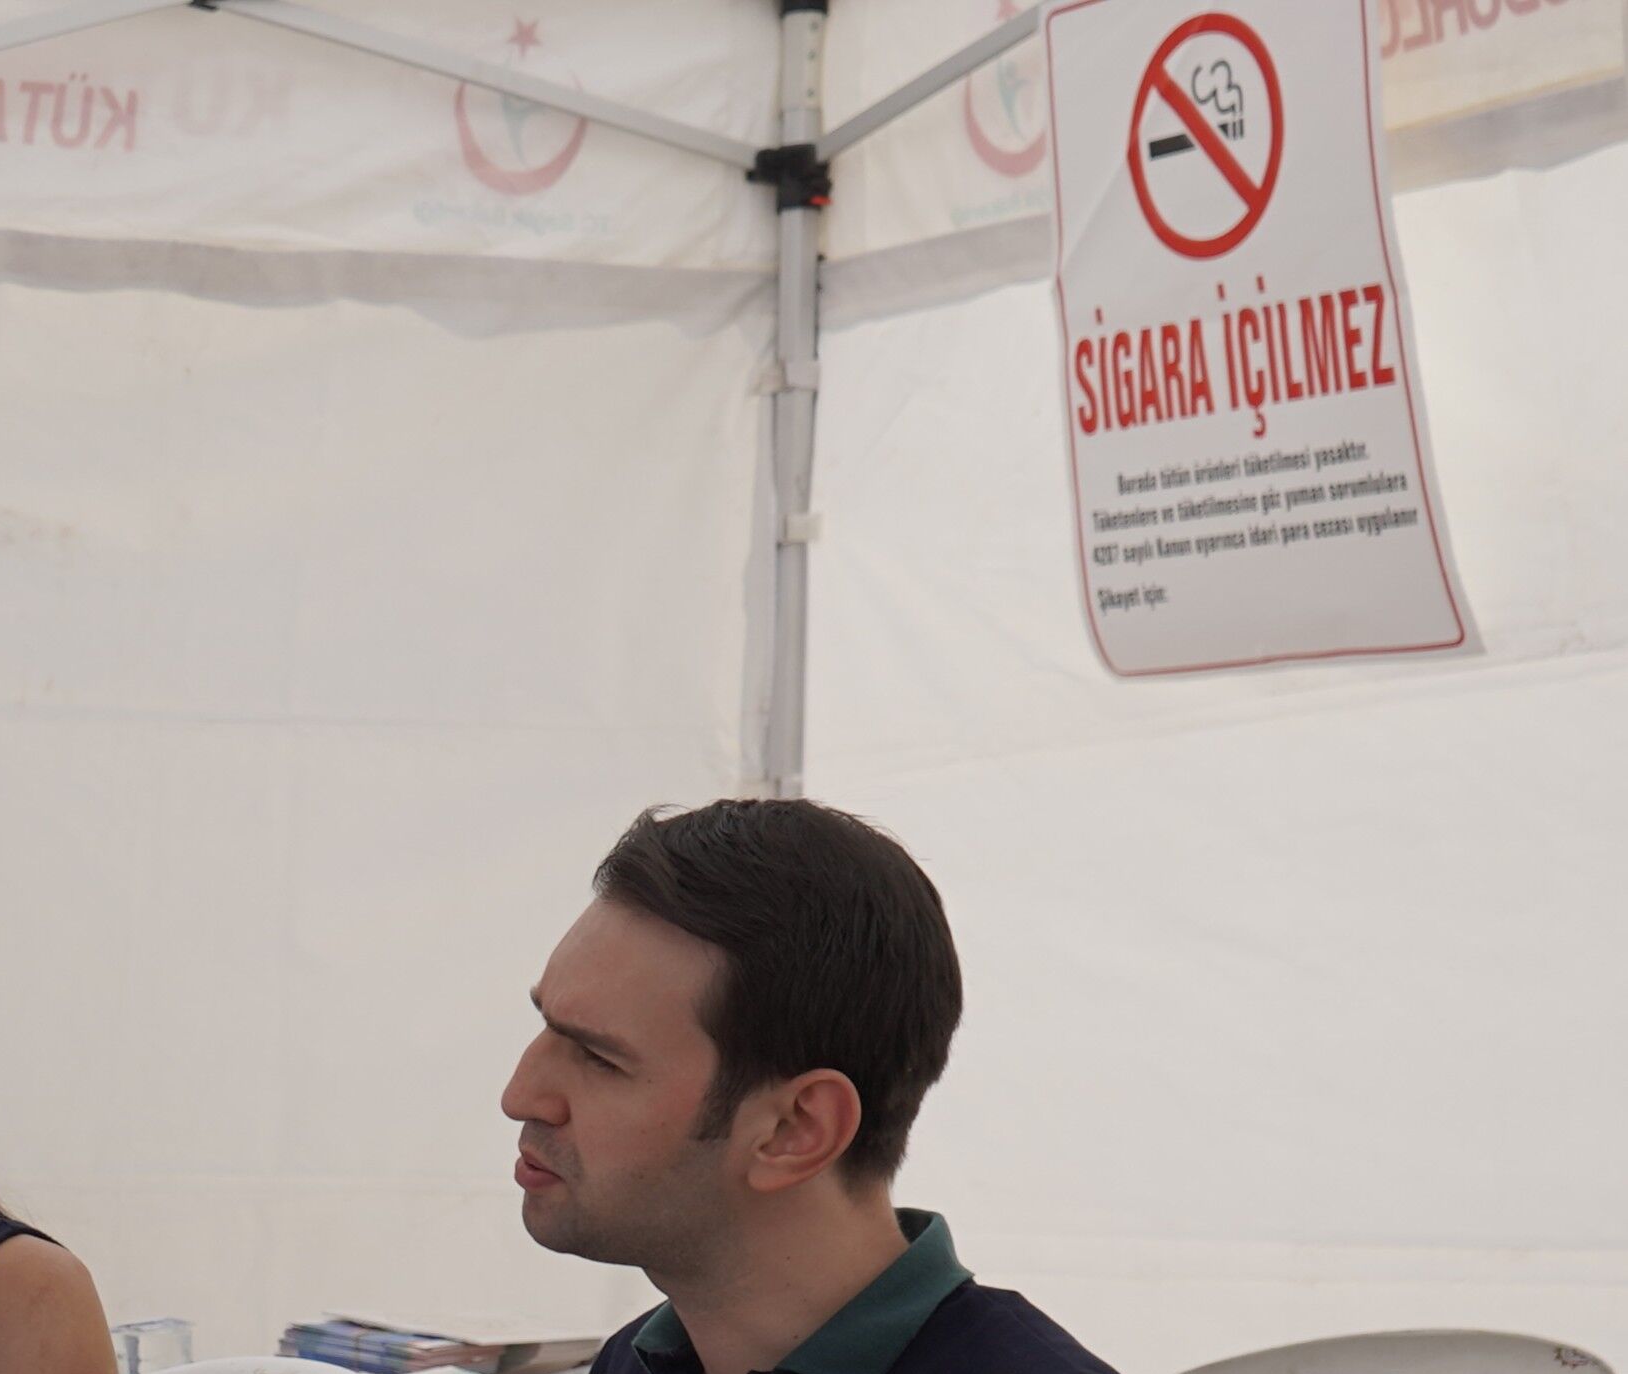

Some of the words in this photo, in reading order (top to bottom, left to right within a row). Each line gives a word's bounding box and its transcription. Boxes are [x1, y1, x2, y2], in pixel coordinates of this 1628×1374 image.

[1075, 306, 1215, 436] SİGARA
[1217, 275, 1396, 439] İÇİLMEZ
[1118, 472, 1158, 496] Burada
[1243, 450, 1311, 478] tüketilmesi
[1156, 536, 1192, 558] Kanun
[1097, 586, 1140, 615] Şikayet
